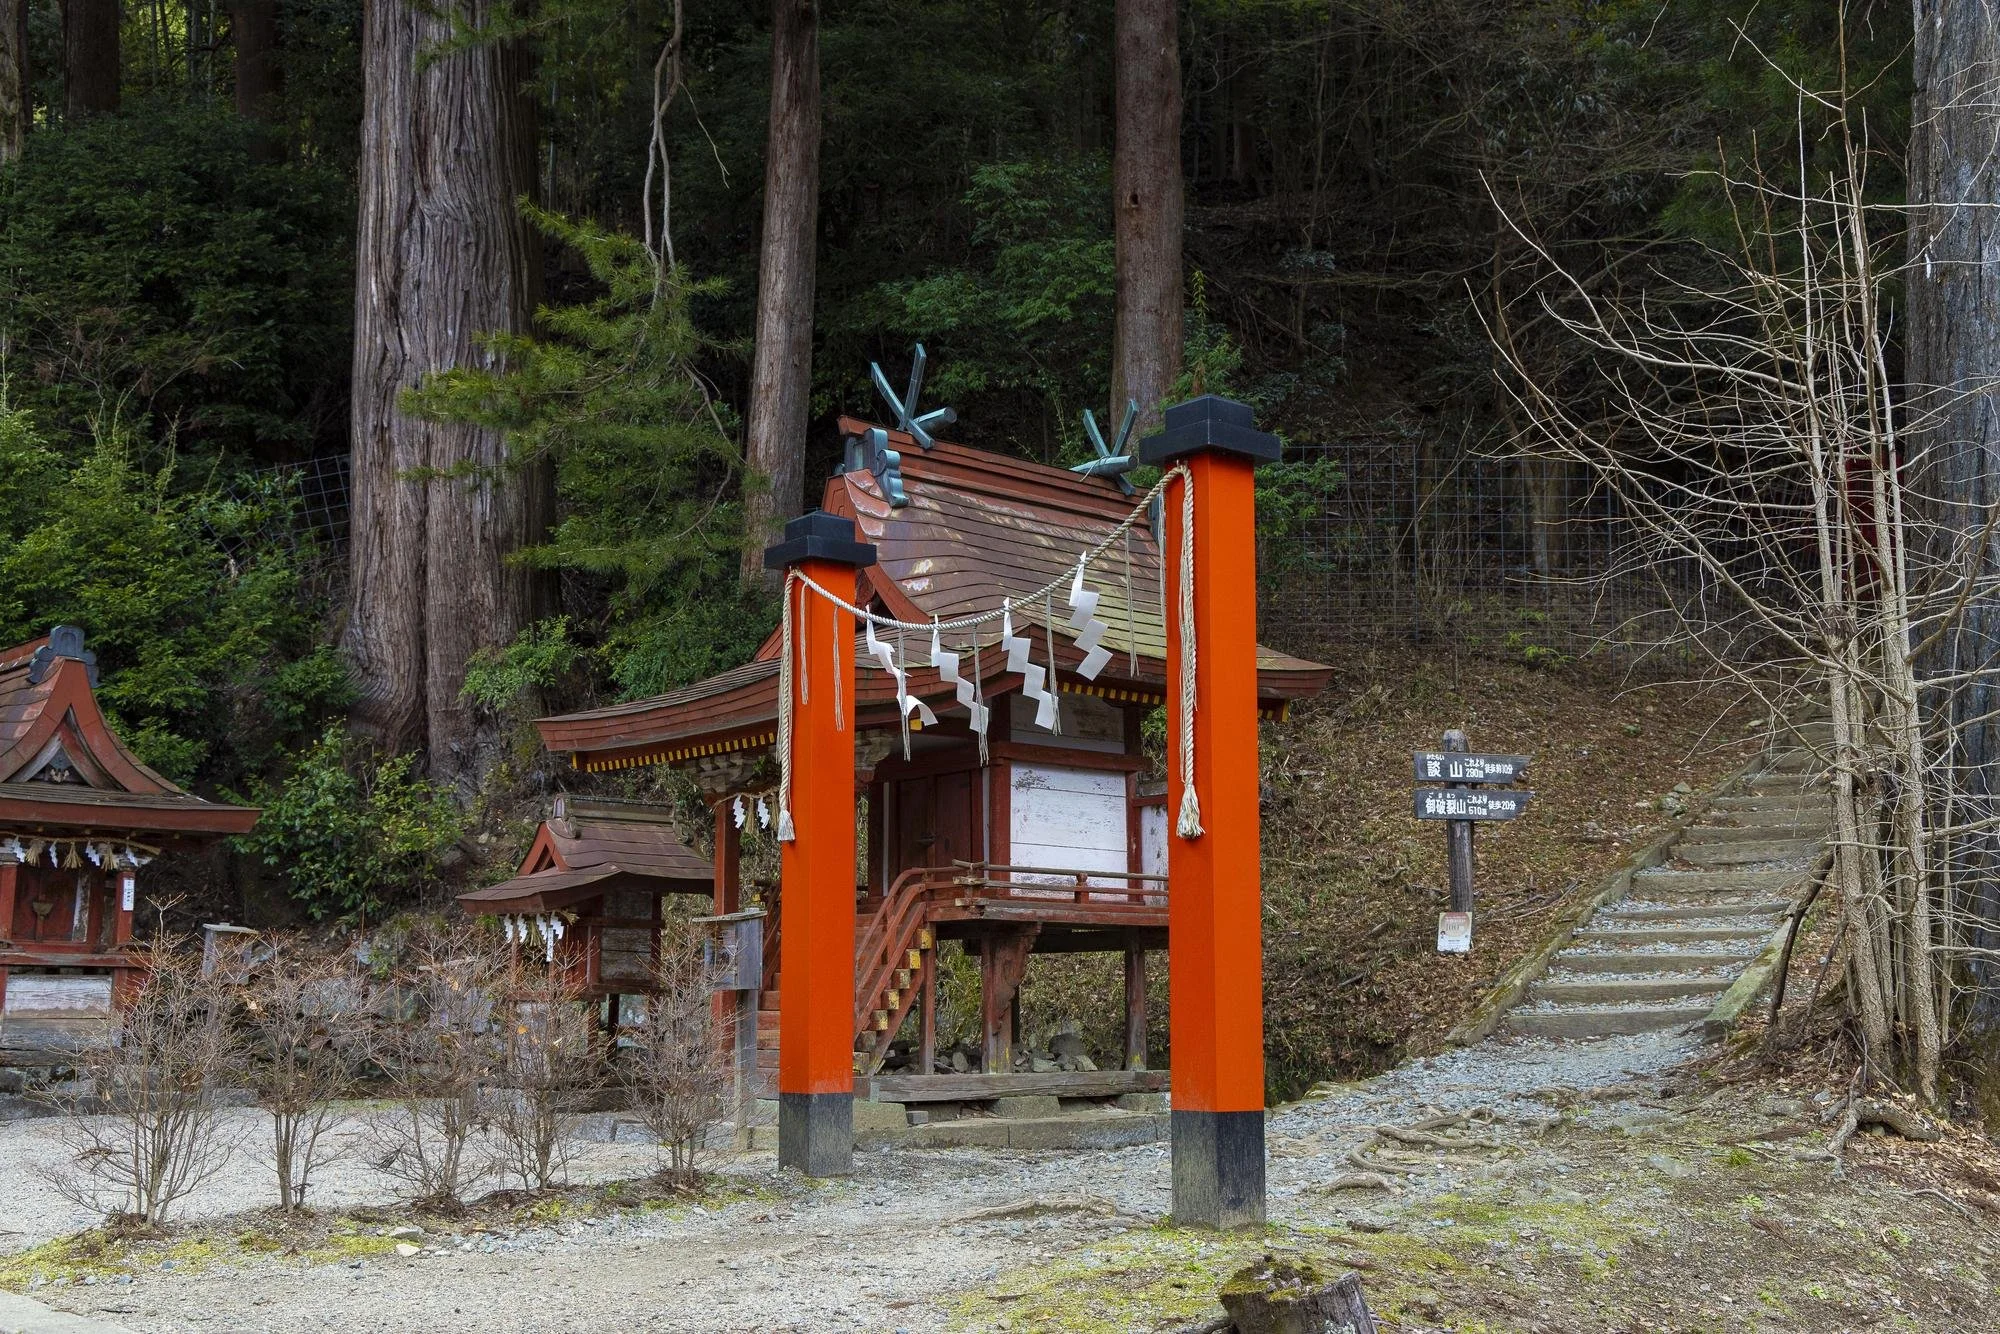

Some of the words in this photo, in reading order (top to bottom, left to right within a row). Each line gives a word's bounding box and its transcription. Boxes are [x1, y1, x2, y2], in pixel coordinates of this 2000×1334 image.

[1464, 757, 1485, 767] これより
[1467, 795, 1488, 804] これより
